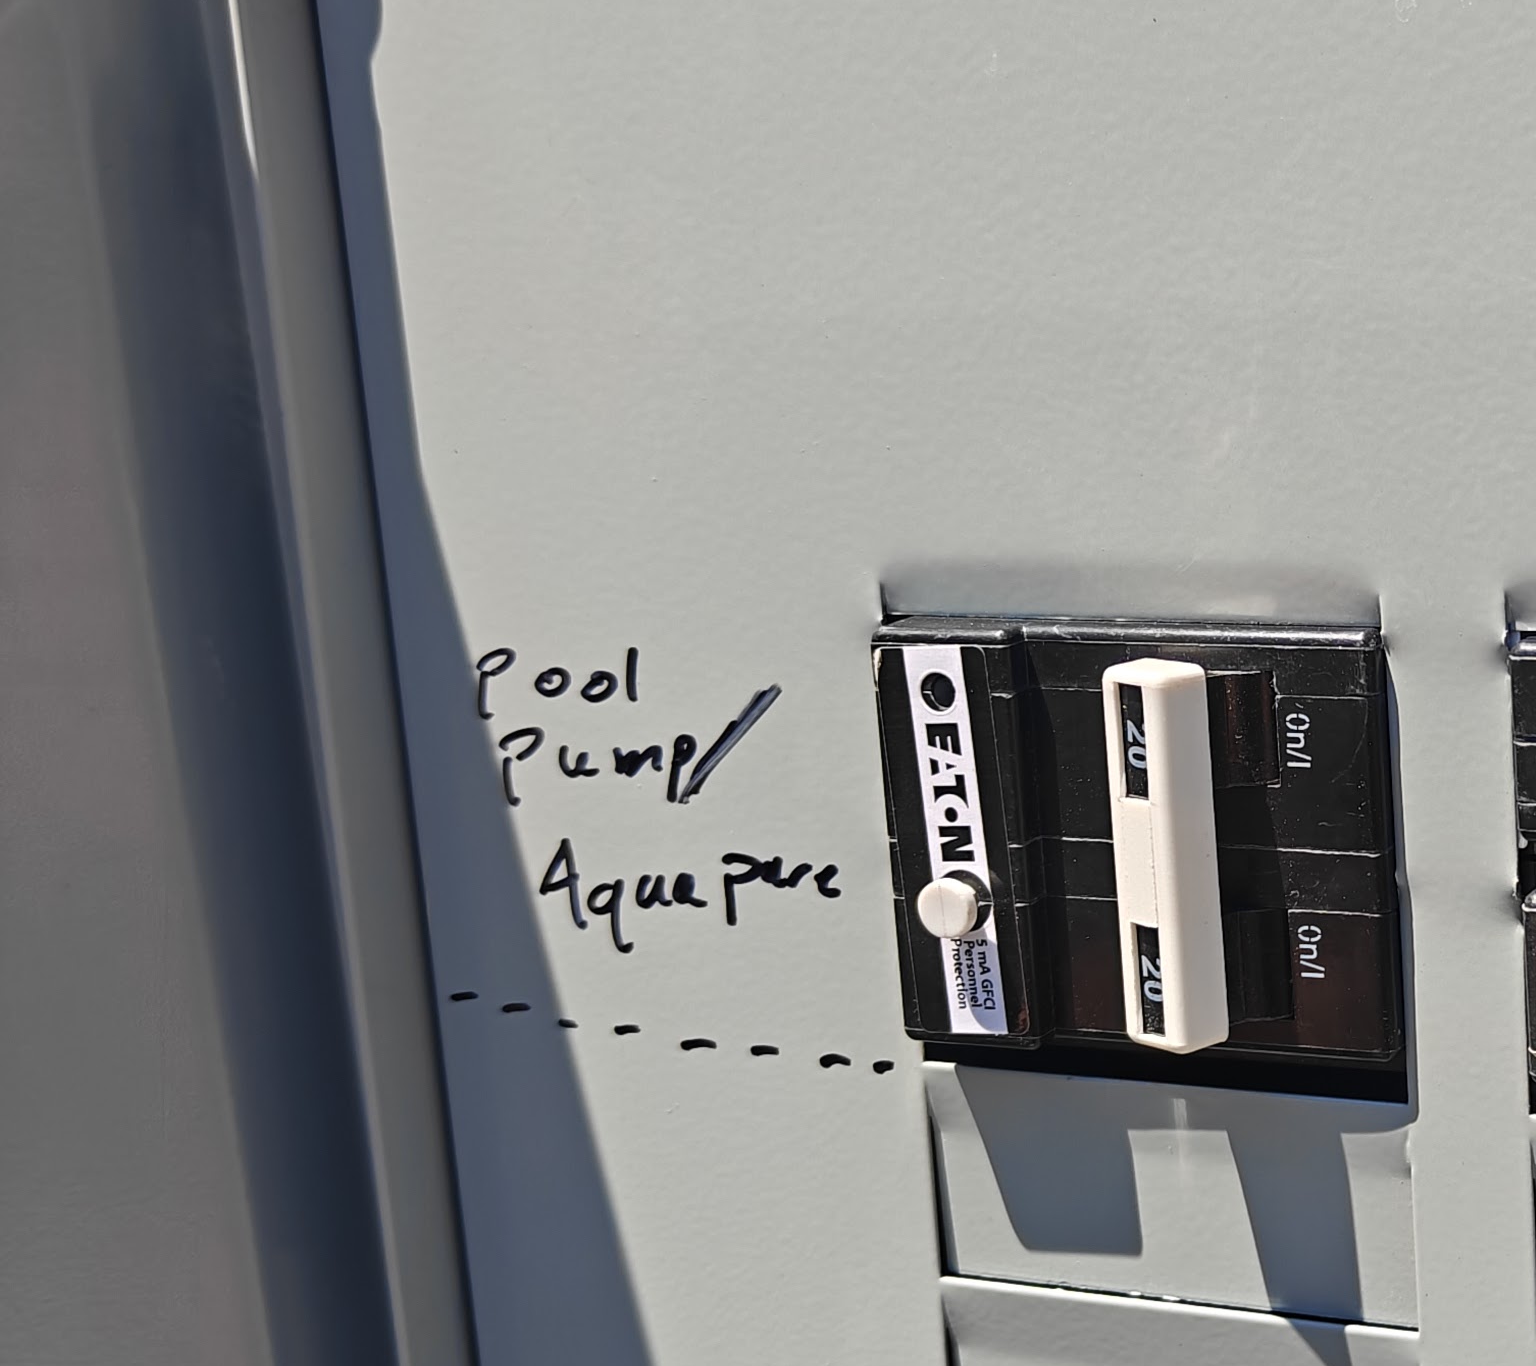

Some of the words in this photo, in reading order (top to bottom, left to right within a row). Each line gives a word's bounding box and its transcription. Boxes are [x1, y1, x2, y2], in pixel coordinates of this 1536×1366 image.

[476, 646, 639, 720] Pool
[924, 722, 976, 863] EATON
[950, 938, 969, 1010] Protection
[962, 939, 983, 1009] Personnel
[975, 938, 989, 948] 5
[977, 950, 992, 976] mA
[980, 978, 997, 1011] GFCI
